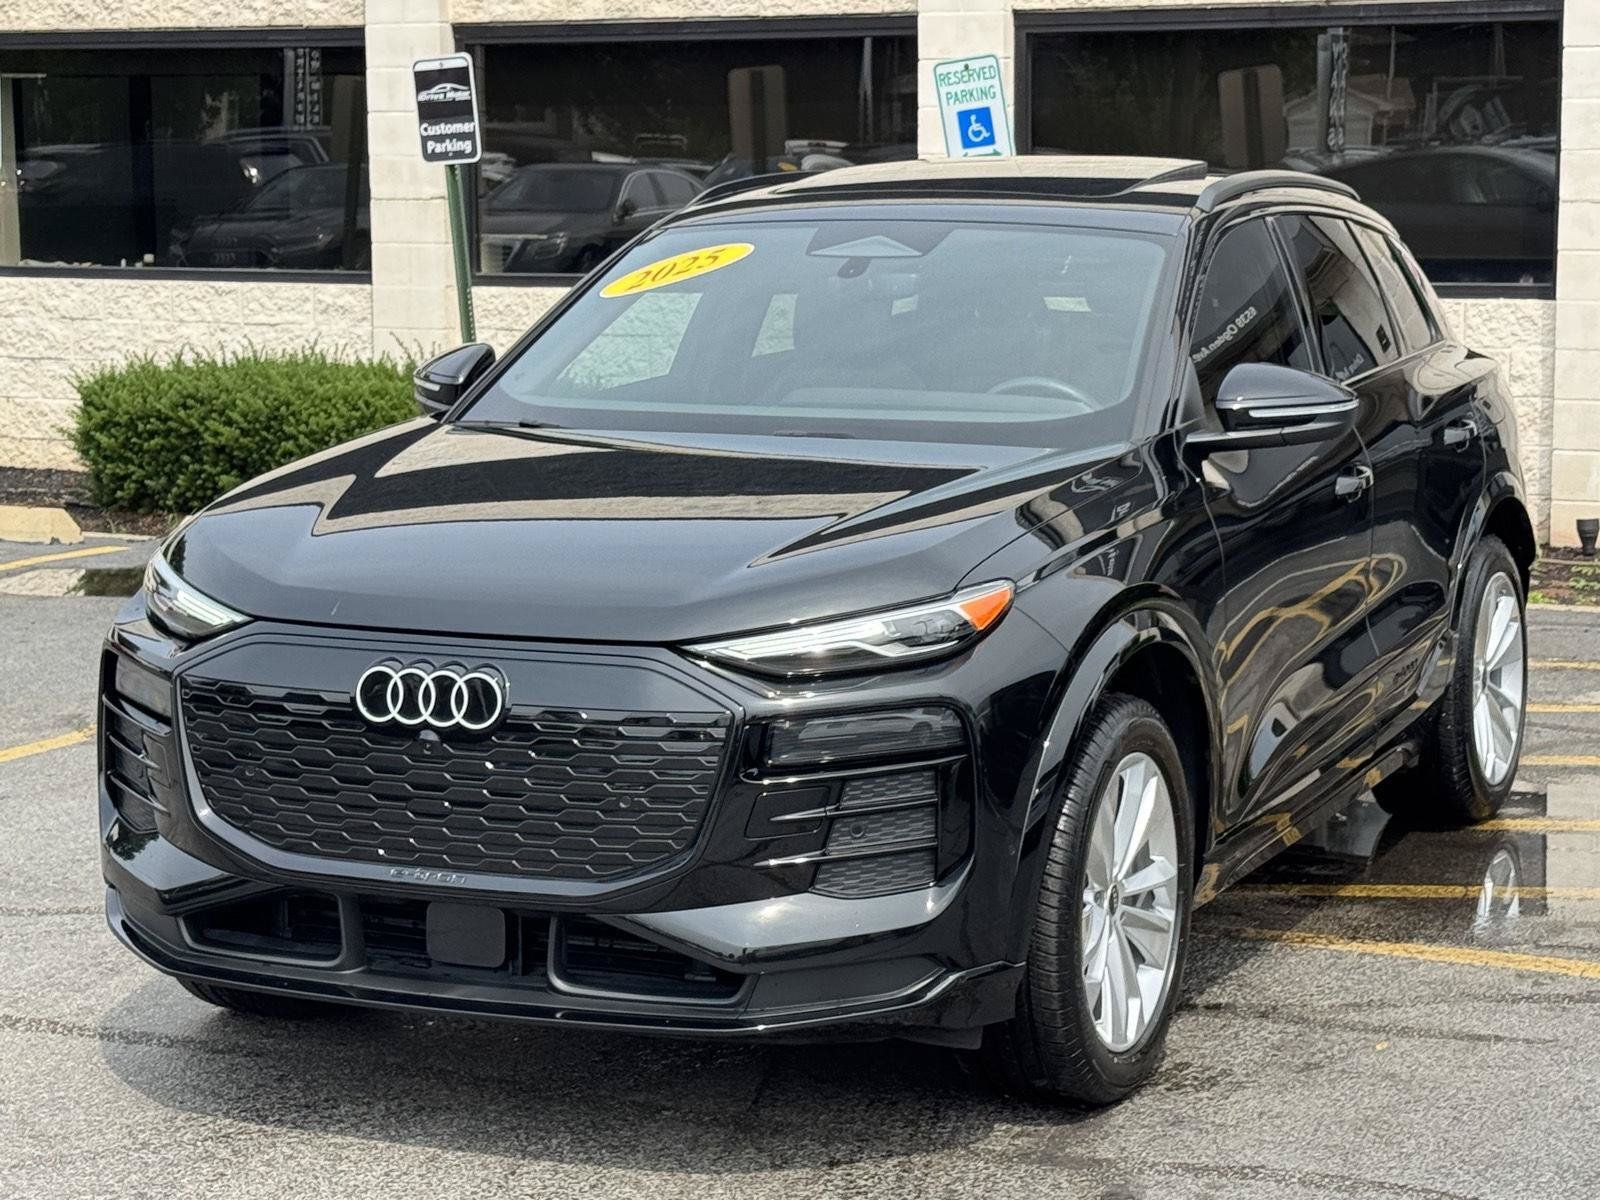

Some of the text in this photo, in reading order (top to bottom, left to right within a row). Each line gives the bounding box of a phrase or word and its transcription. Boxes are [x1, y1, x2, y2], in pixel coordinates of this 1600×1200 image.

[938, 65, 997, 87] RESERVED
[946, 85, 996, 106] PARKING
[420, 122, 475, 136] Customer
[427, 138, 472, 154] Parking
[624, 248, 726, 291] 2025
